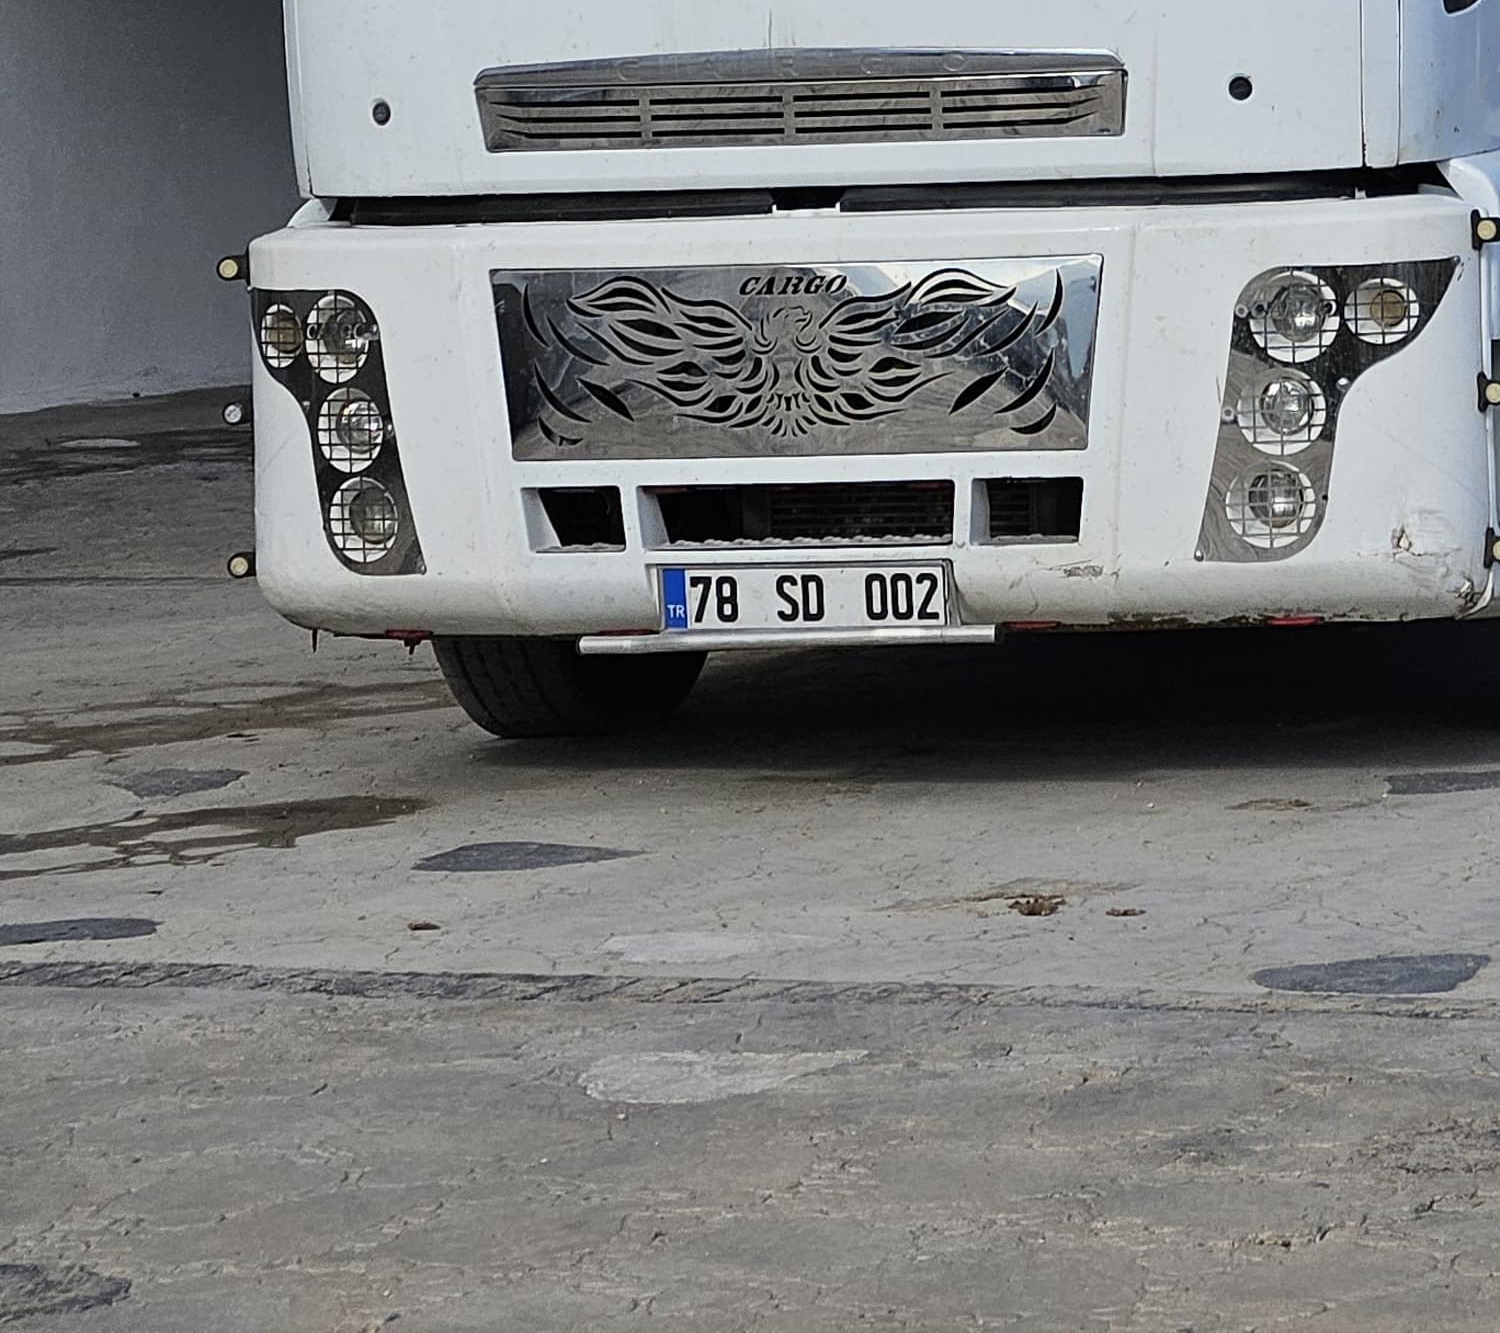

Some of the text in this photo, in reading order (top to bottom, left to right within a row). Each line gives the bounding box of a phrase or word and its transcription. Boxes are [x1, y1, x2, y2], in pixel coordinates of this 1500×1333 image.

[738, 274, 848, 296] CARGO
[666, 572, 941, 624] TR 78 SD 002
